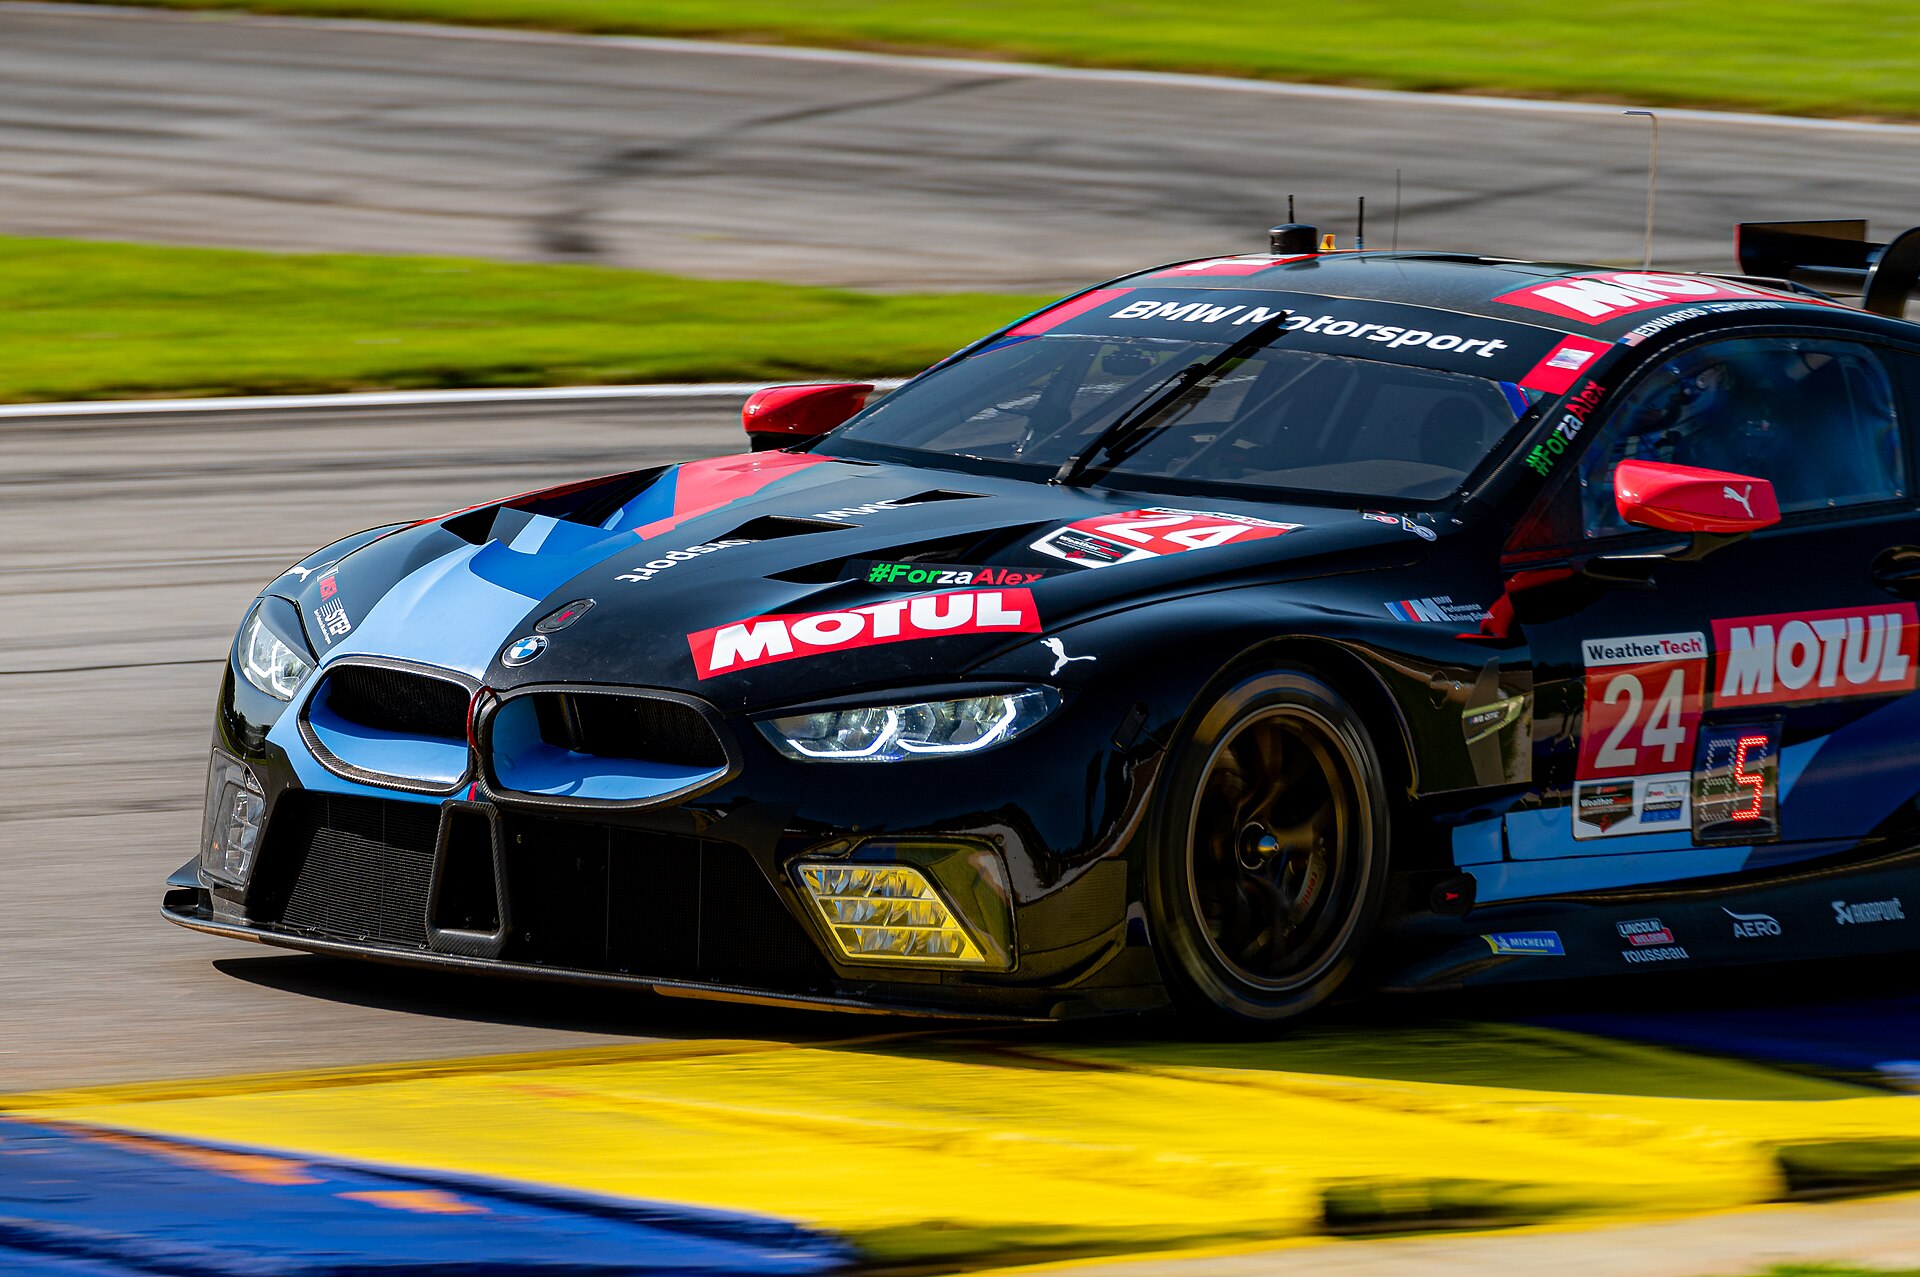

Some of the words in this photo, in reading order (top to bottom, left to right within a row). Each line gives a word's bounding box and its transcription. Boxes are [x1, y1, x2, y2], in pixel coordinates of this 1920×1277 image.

[1109, 299, 1247, 323] BMW
[1232, 305, 1508, 358] Motorsport
[1632, 307, 1708, 338] EDWARDS
[1526, 381, 1606, 476] #ForzaAlex
[1094, 514, 1254, 550] 24
[868, 562, 1043, 586] #ForzaAlex
[325, 608, 351, 636] STEP
[709, 592, 1023, 671] MOTUL
[1721, 613, 1910, 697] MOTUL
[1594, 669, 1686, 769] 24
[1731, 735, 1769, 821] 5
[1509, 937, 1556, 948] MICHELIN
[1619, 920, 1661, 934] LINCOLN
[1733, 921, 1782, 938] AERO
[1621, 946, 1690, 963] rousseau
